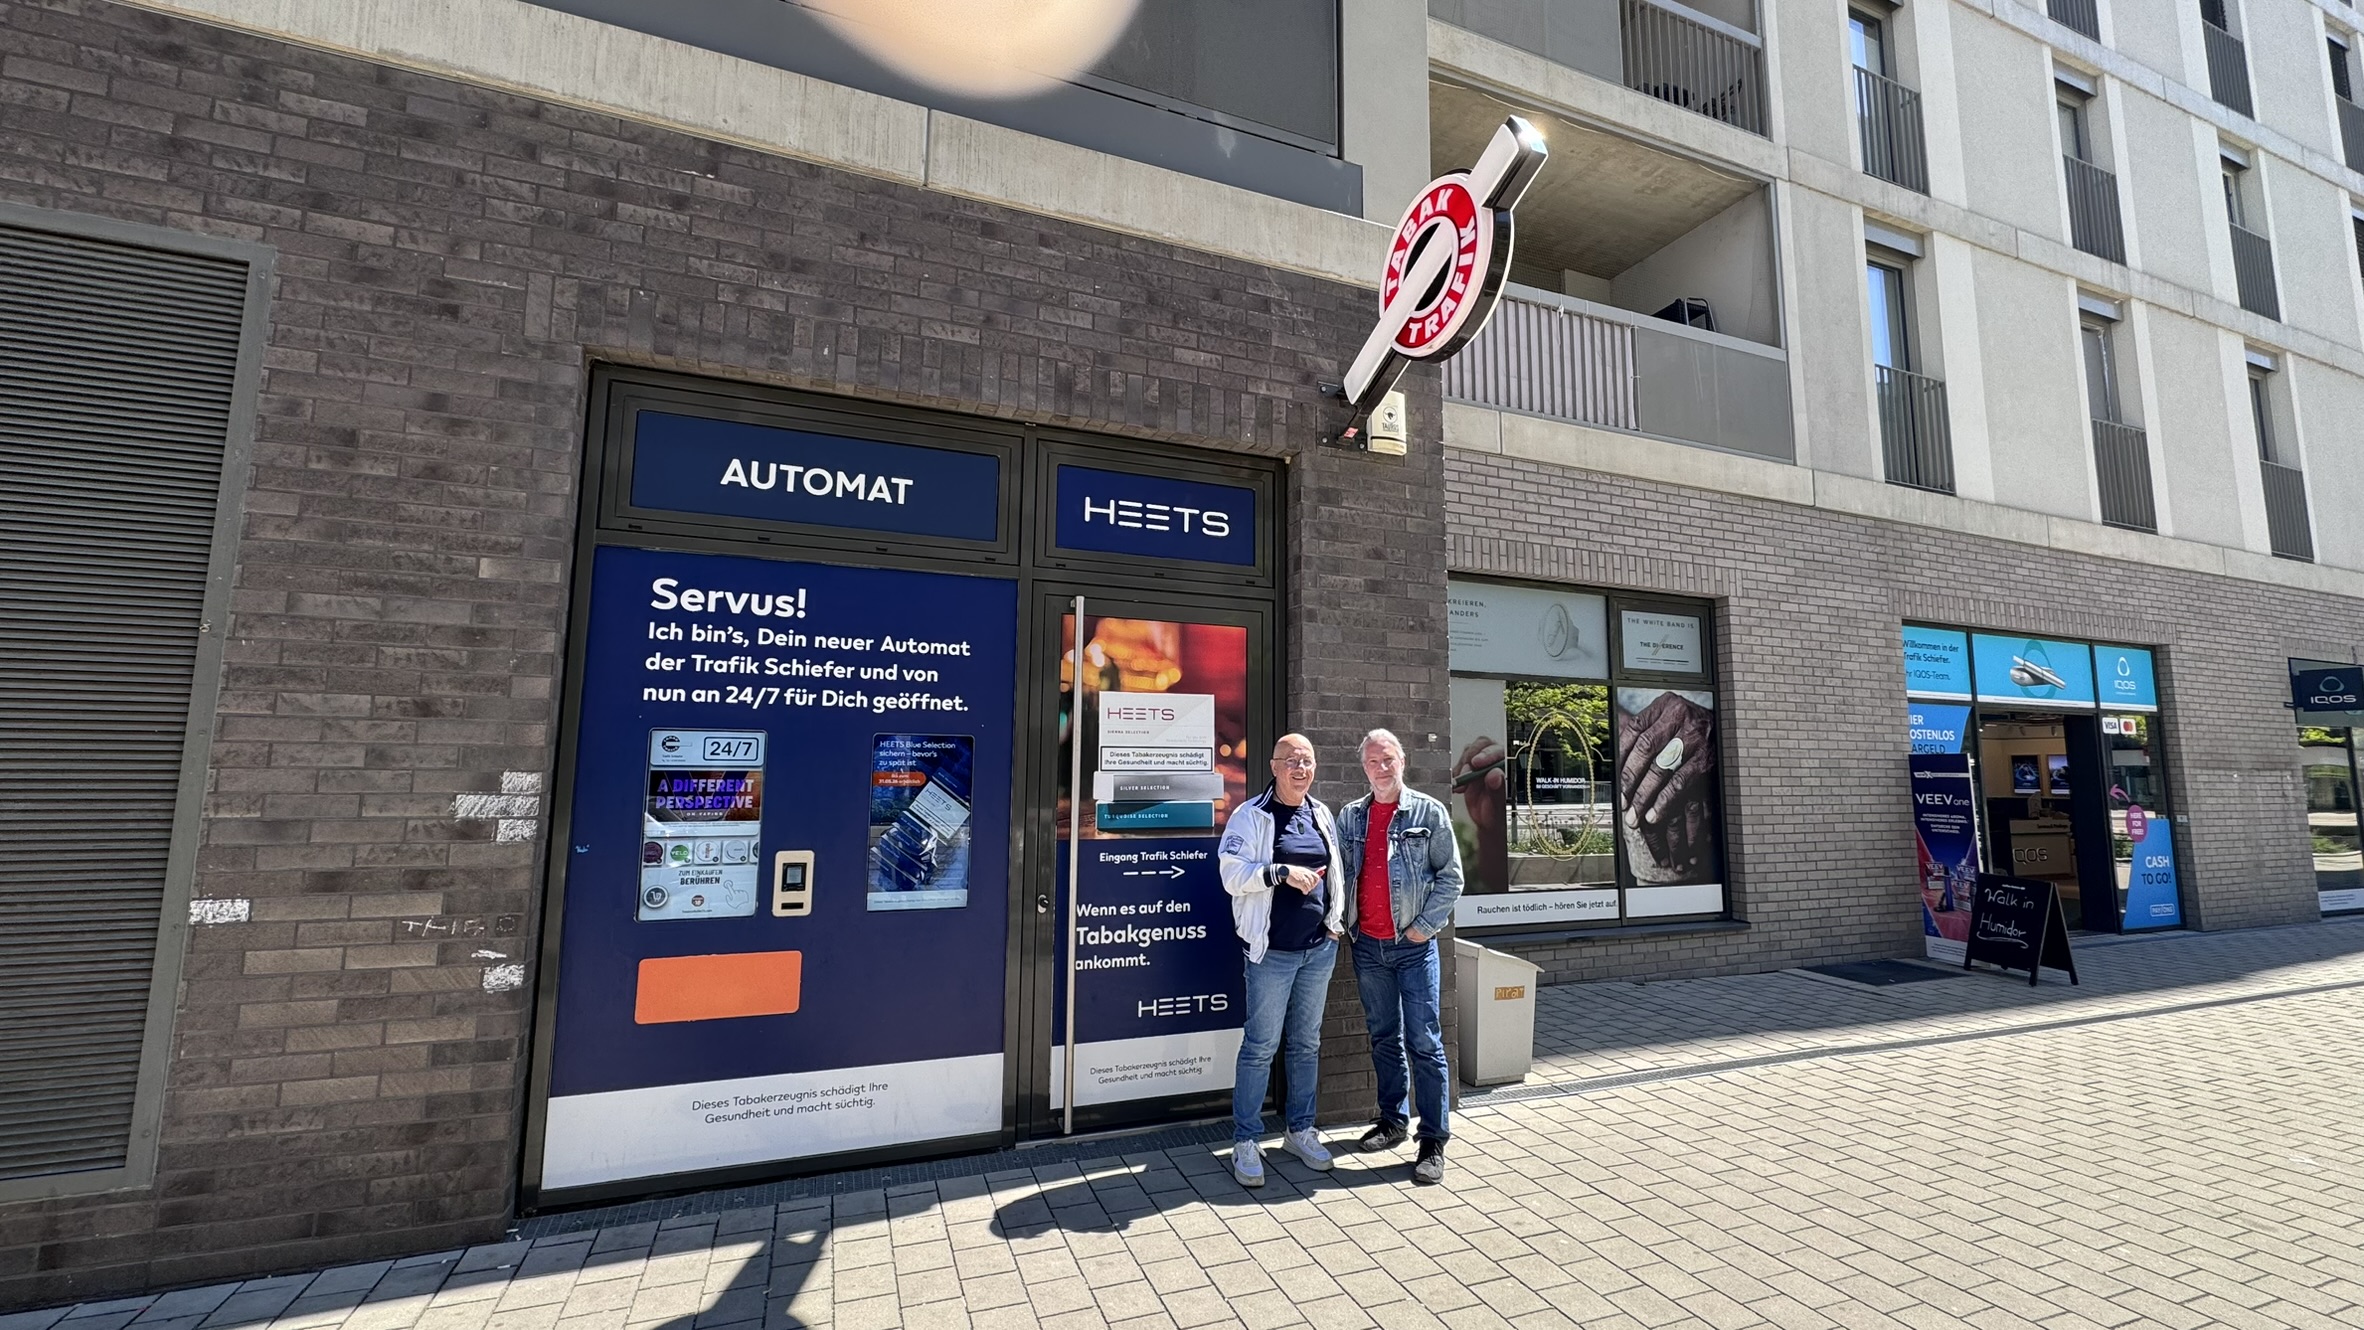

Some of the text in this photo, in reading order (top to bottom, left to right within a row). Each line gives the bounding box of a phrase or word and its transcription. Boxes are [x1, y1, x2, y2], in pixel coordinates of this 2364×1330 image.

[1386, 188, 1454, 298] TABAK
[1408, 215, 1476, 344] TRAFIK
[720, 458, 914, 504] AUTOMAT
[1084, 496, 1230, 537] HEETS
[650, 577, 807, 619] Servus!
[1449, 610, 1479, 618] ANDERS
[648, 622, 971, 657] Ich bin’s, Dein neuer Automat
[1942, 643, 1948, 651] in
[1948, 643, 1959, 652] der
[645, 652, 939, 683] der Trafik Schiefer und von
[2114, 680, 2136, 690] IQOS
[643, 686, 969, 718] nun an 24/7 für Dich geöffnet.
[2310, 695, 2357, 704] IQOS
[1107, 707, 1175, 721] HEETS
[1909, 714, 1924, 725] IER
[2104, 721, 2117, 729] VISA
[1909, 729, 1955, 741] OSTENLOS
[709, 740, 753, 757] 24/7
[922, 741, 956, 749] Selection
[1911, 743, 1946, 754] ARGELD
[1132, 751, 1178, 759] Tabakerzeugnis
[1179, 751, 1204, 759] schädigt
[657, 779, 754, 792] A DIFFERENT
[655, 795, 753, 808] PERSPECTIVE
[1915, 793, 1953, 805] VEEV
[1100, 850, 1208, 864] Eingang Trafik Schiefer
[2012, 847, 2048, 865] QOS
[2145, 856, 2170, 868] CASH
[679, 875, 721, 885] BERÜHREN
[2141, 872, 2172, 885] TO GO!
[1984, 888, 2034, 909] Walk in
[1076, 900, 1191, 917] Wenn es auf den
[1477, 905, 1510, 914] Rauchen
[1522, 904, 1547, 912] tödlich
[1554, 902, 1575, 910] hören
[1588, 900, 1604, 910] jetzt
[1979, 912, 2027, 937] Humidor
[1076, 923, 1207, 947] Tabakgenuss
[1075, 954, 1151, 970] ankommt.
[1138, 994, 1228, 1018] HEETS
[1090, 1055, 1212, 1075] Dieses Tabakerzeugnis schädigt Ihre
[1098, 1074, 1138, 1084] Gesundheit
[1140, 1072, 1153, 1080] und
[1154, 1069, 1177, 1077] macht
[692, 1081, 889, 1111] Dieses Tabakerzeugnis schädigt Ihre
[704, 1097, 876, 1124] Gesundheit und macht süchtig.
